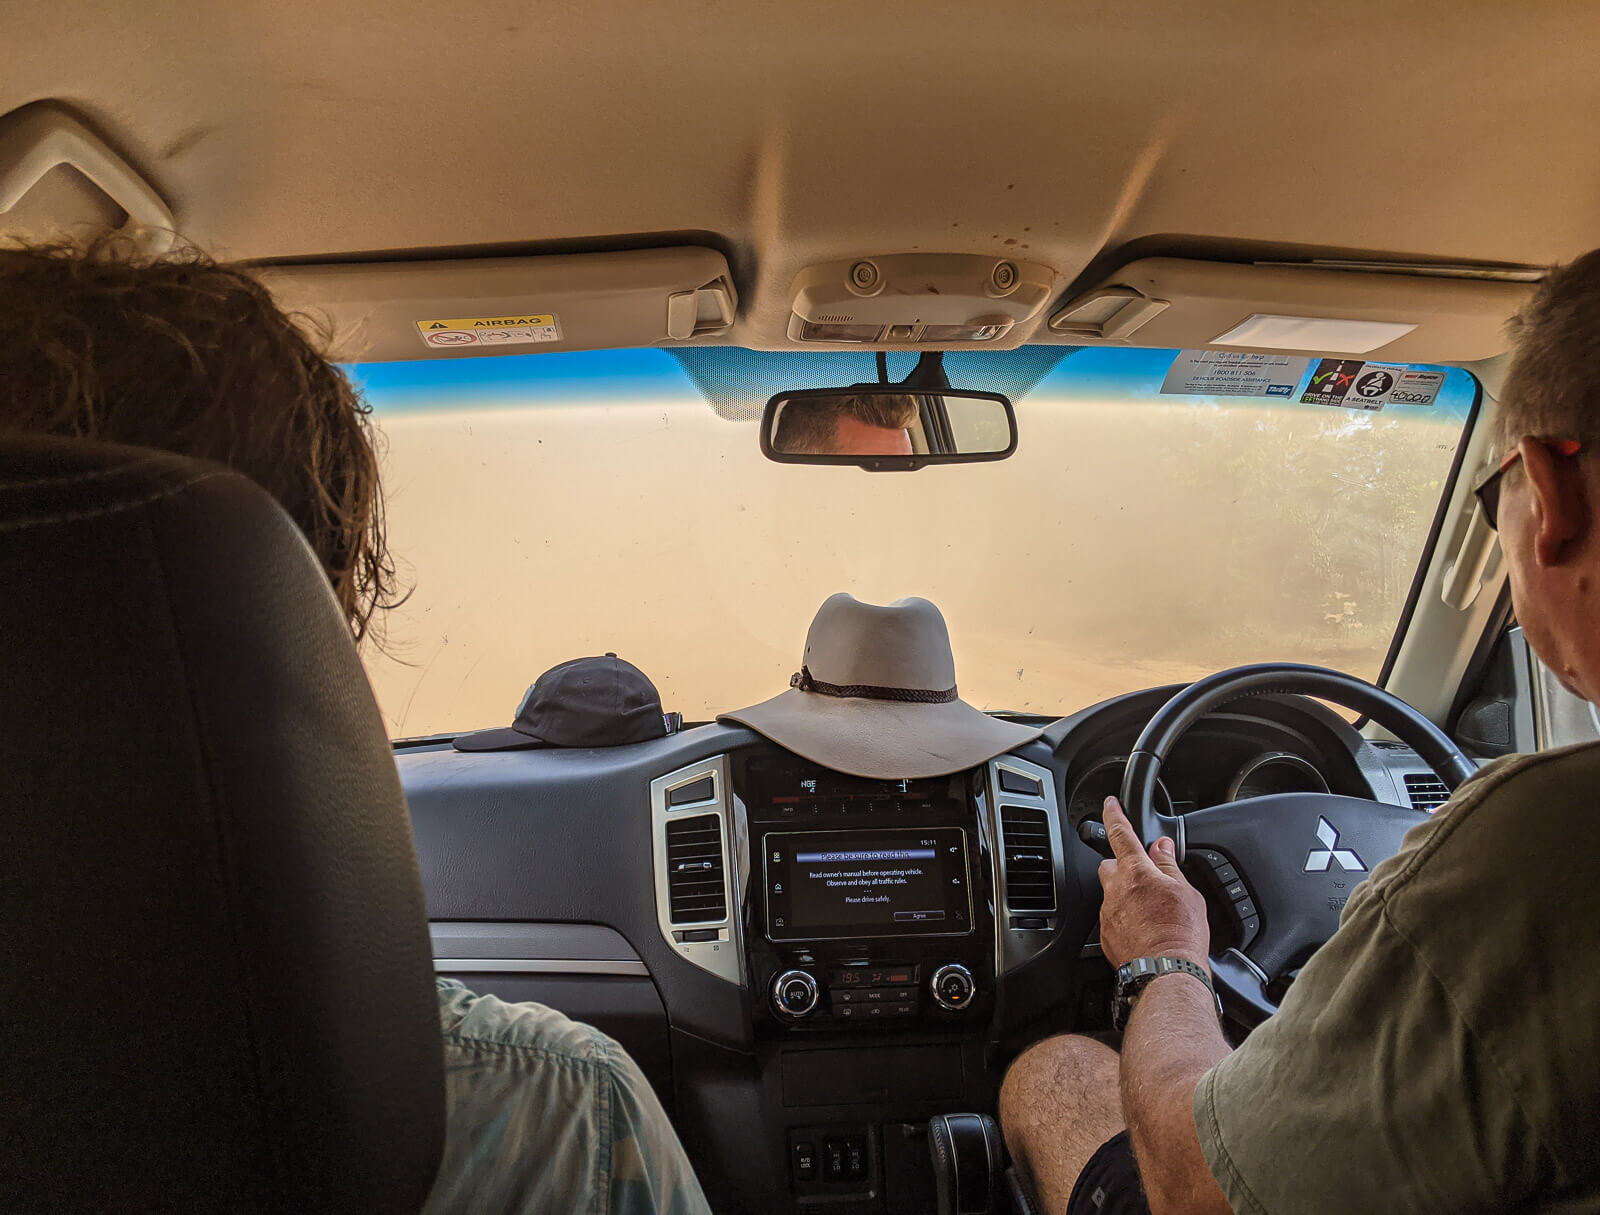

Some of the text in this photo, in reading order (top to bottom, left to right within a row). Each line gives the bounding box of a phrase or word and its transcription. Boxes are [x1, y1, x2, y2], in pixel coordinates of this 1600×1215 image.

[474, 318, 542, 327] AIRBAG
[1351, 397, 1384, 405] SEATBELT
[821, 853, 842, 861] Please
[844, 852, 852, 860] be
[879, 851, 895, 859] read
[809, 871, 823, 879] Read
[862, 869, 879, 877] before
[880, 869, 904, 878] operating
[858, 879, 871, 887] obey
[912, 912, 927, 920] Agree
